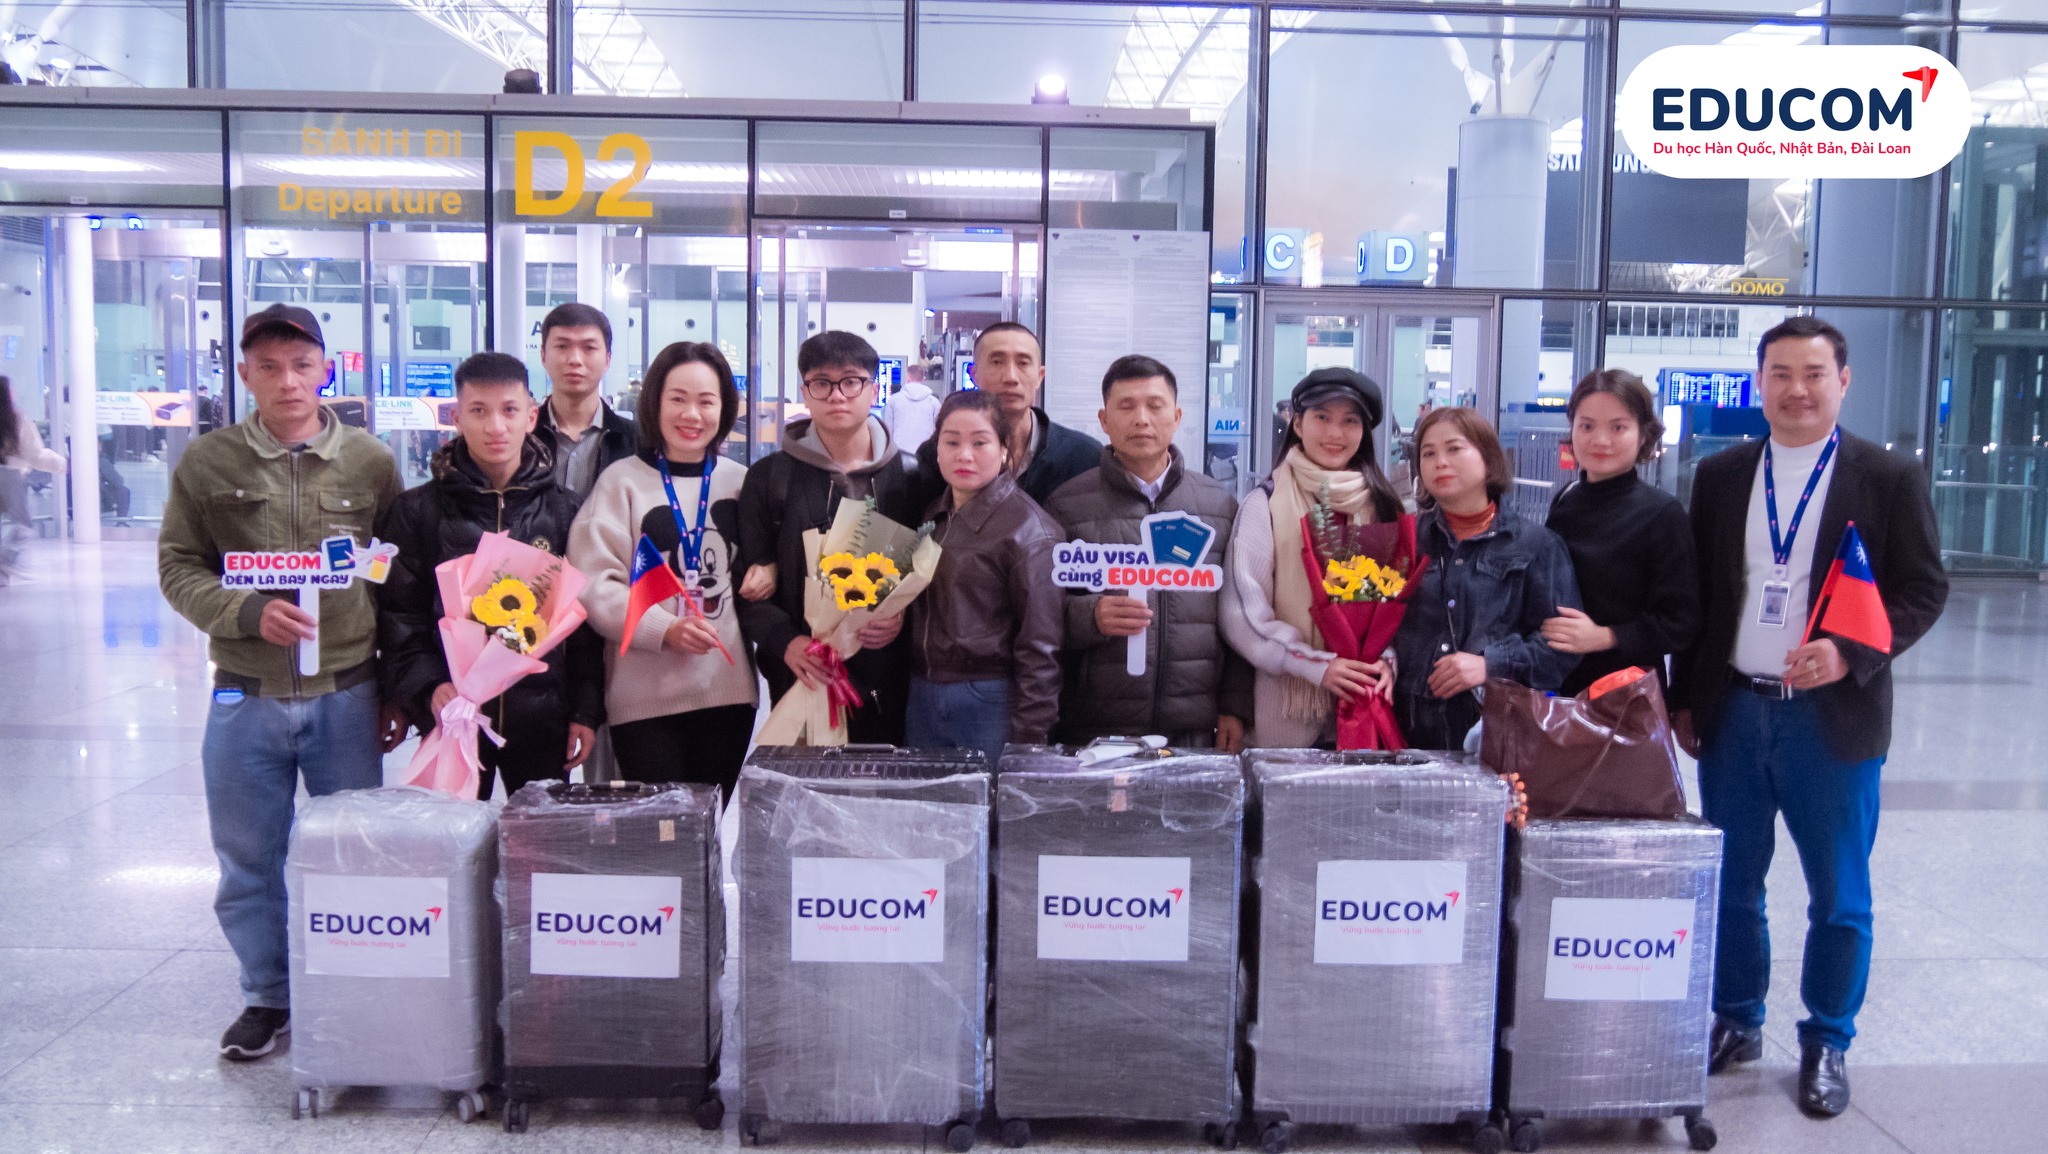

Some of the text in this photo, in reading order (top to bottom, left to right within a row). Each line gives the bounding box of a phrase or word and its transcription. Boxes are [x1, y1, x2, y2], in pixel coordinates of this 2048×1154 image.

[425, 128, 461, 158] ĐI
[515, 131, 653, 217] D2
[279, 182, 462, 219] Departure
[1265, 233, 1295, 270] C
[1386, 237, 1414, 273] D
[1731, 281, 1785, 296] DOMO
[226, 554, 321, 570] EDUCOM
[1103, 550, 1150, 565] VISA
[258, 573, 275, 585] LÀ
[279, 574, 306, 585] BAY
[311, 574, 349, 585] NGAY
[1057, 567, 1215, 587] cùng EDUCOM
[798, 898, 925, 919] EDUCOM
[1044, 895, 1171, 918] EDUCOM
[1321, 900, 1447, 921] EDUCOM
[310, 913, 430, 936] EDUCOM
[537, 912, 662, 936] EDUCOM
[1554, 936, 1675, 959] EDUCOM
